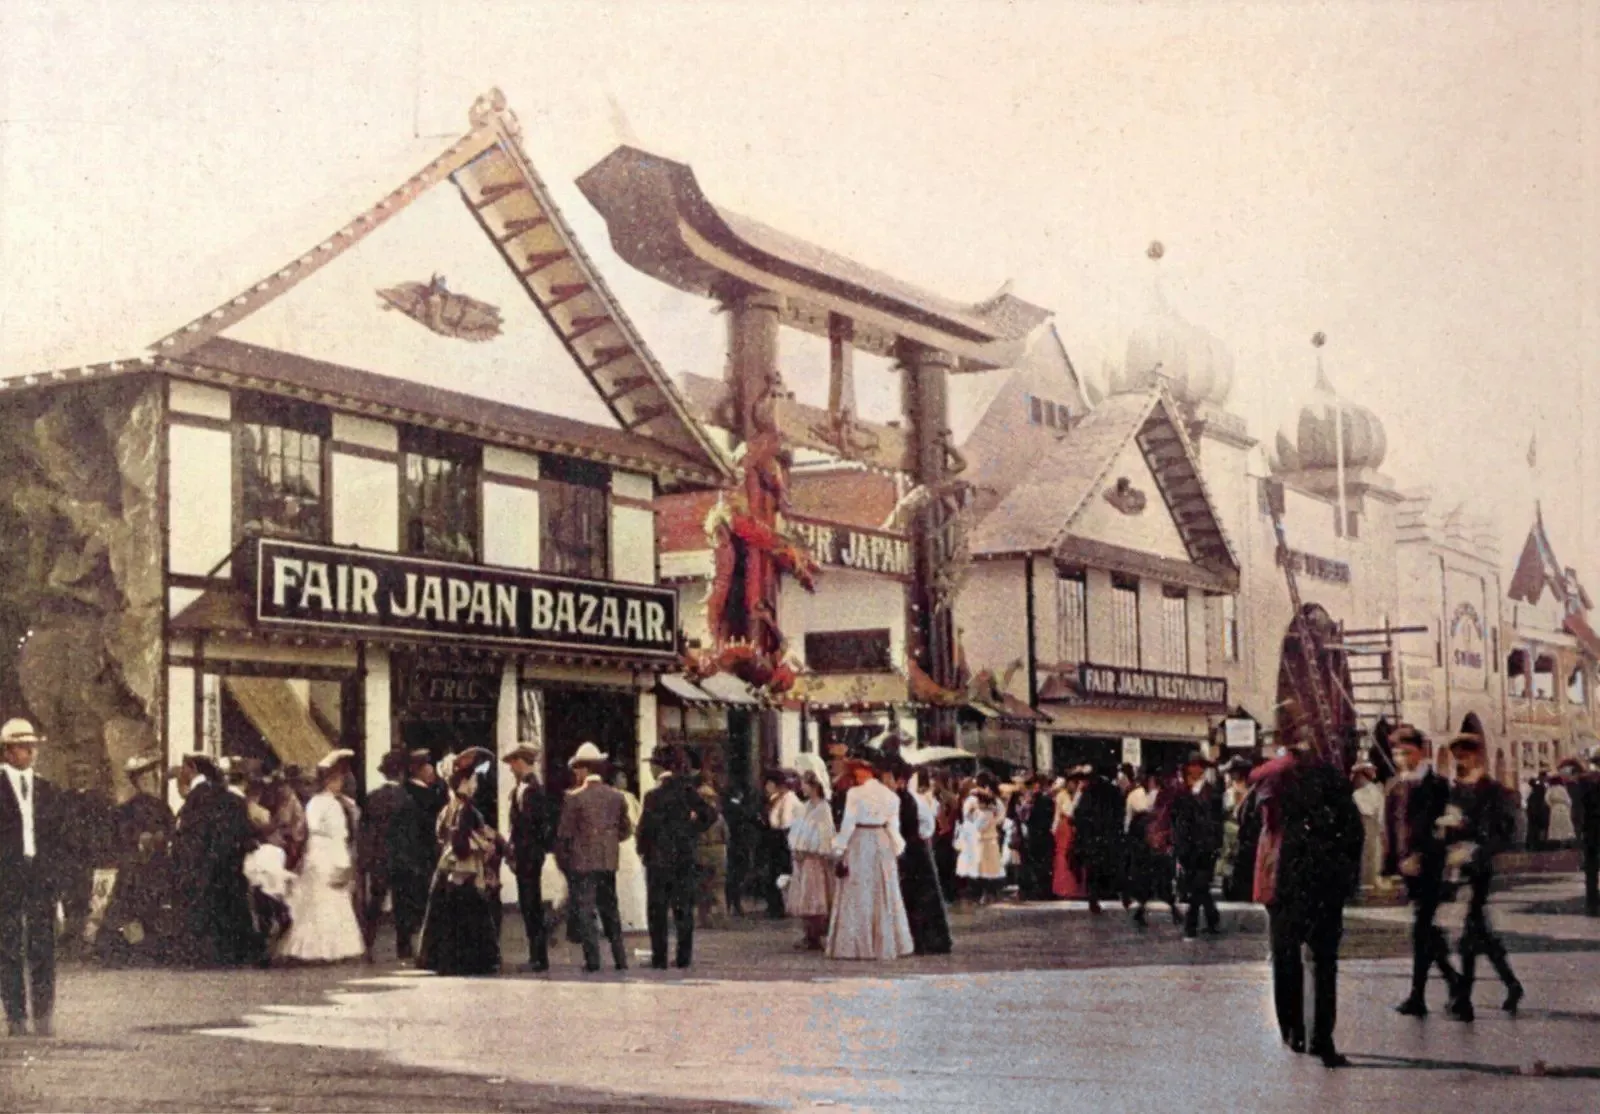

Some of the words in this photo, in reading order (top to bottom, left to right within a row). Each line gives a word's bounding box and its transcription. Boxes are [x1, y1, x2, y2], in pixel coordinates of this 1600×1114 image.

[841, 531, 909, 575] JAPAN
[272, 556, 379, 615] FAIR
[390, 573, 518, 629] JAPAN
[531, 588, 673, 643] BAZAAR.
[1085, 669, 1115, 693] FAIR
[1117, 671, 1155, 697] JAPAN
[1157, 676, 1224, 703] RESTAURANT
